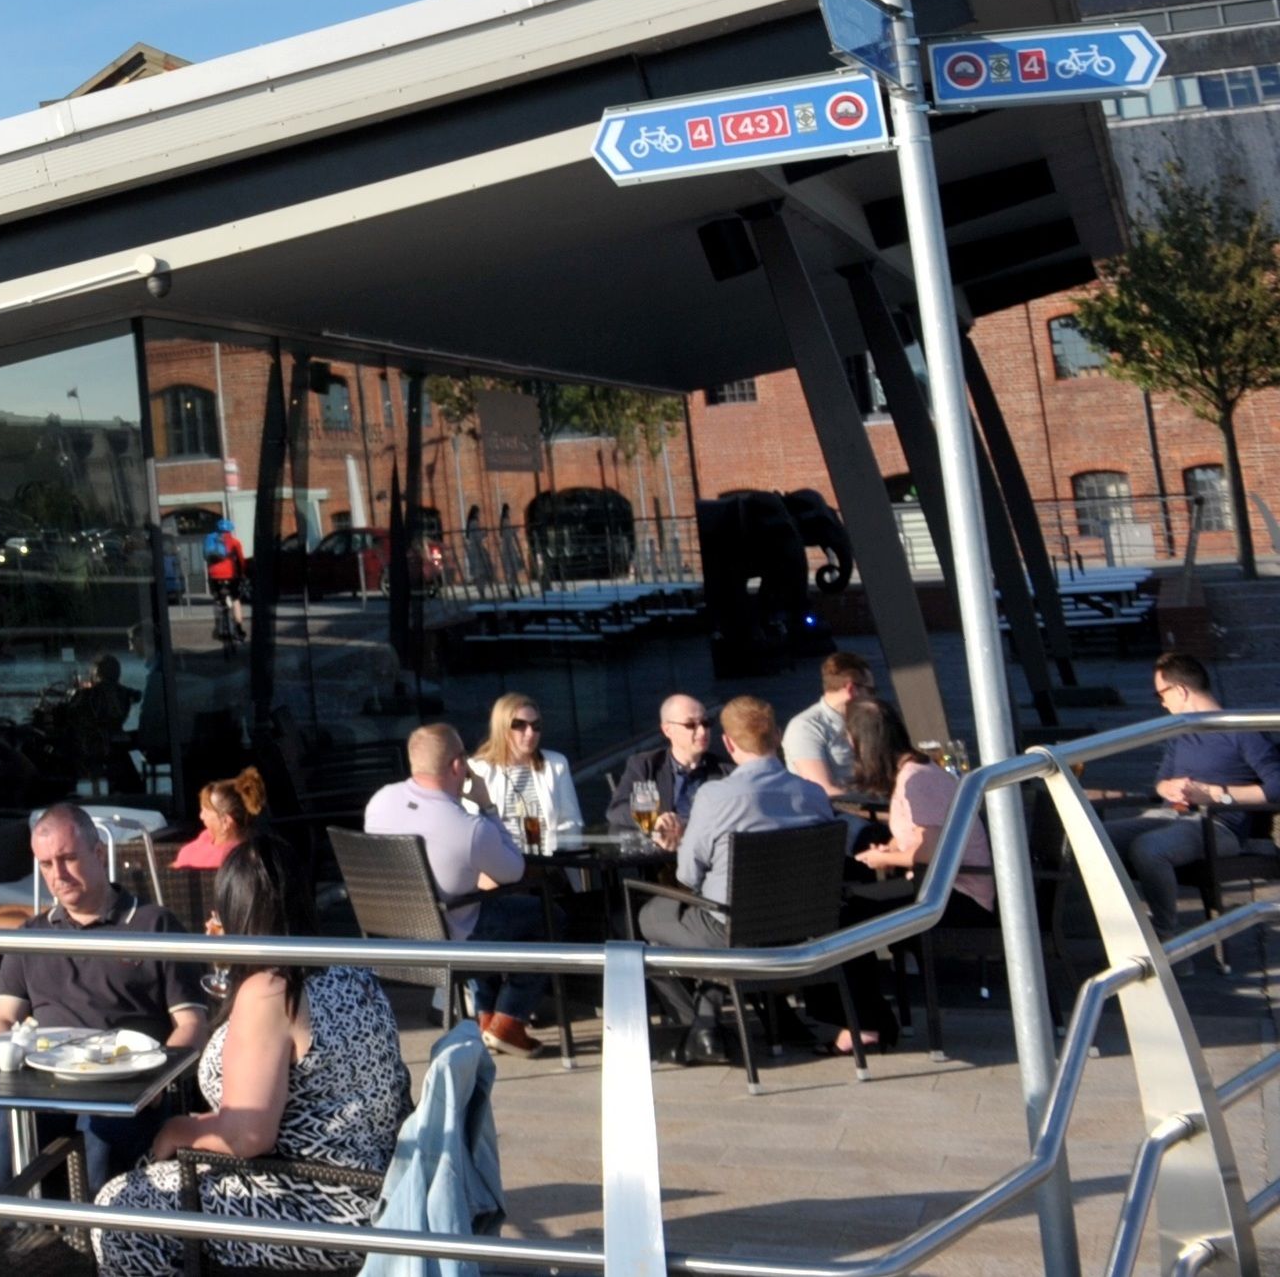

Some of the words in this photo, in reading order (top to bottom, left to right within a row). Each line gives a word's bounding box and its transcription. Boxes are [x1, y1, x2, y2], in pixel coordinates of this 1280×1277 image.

[1023, 55, 1042, 75] 4
[693, 124, 709, 143] 4
[725, 110, 784, 140] (43)
